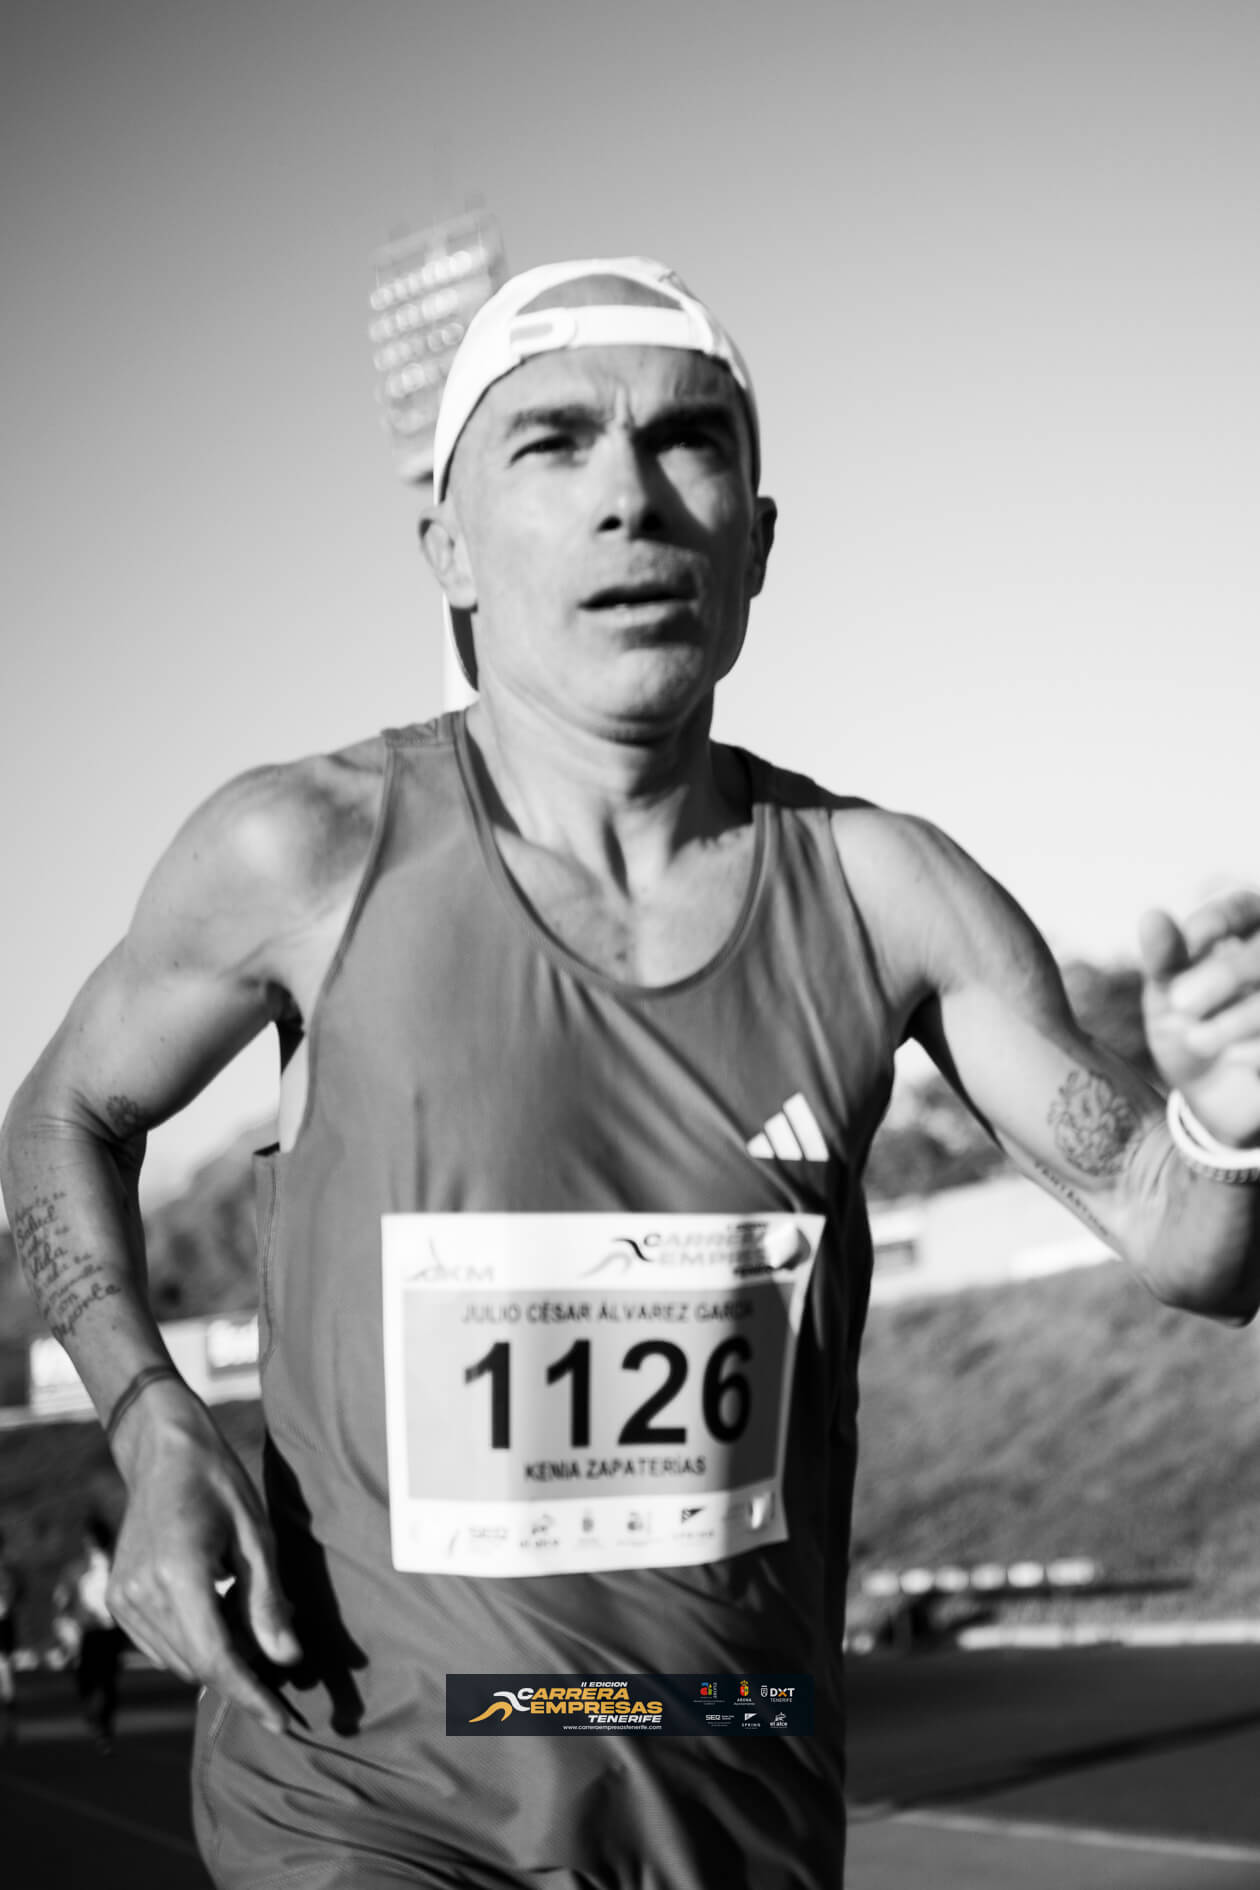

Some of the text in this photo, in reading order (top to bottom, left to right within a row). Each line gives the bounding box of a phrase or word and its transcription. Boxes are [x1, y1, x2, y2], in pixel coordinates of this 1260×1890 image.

[461, 1302, 522, 1325] JULIO
[526, 1299, 591, 1325] CÉSAR
[464, 1335, 752, 1449] 1126
